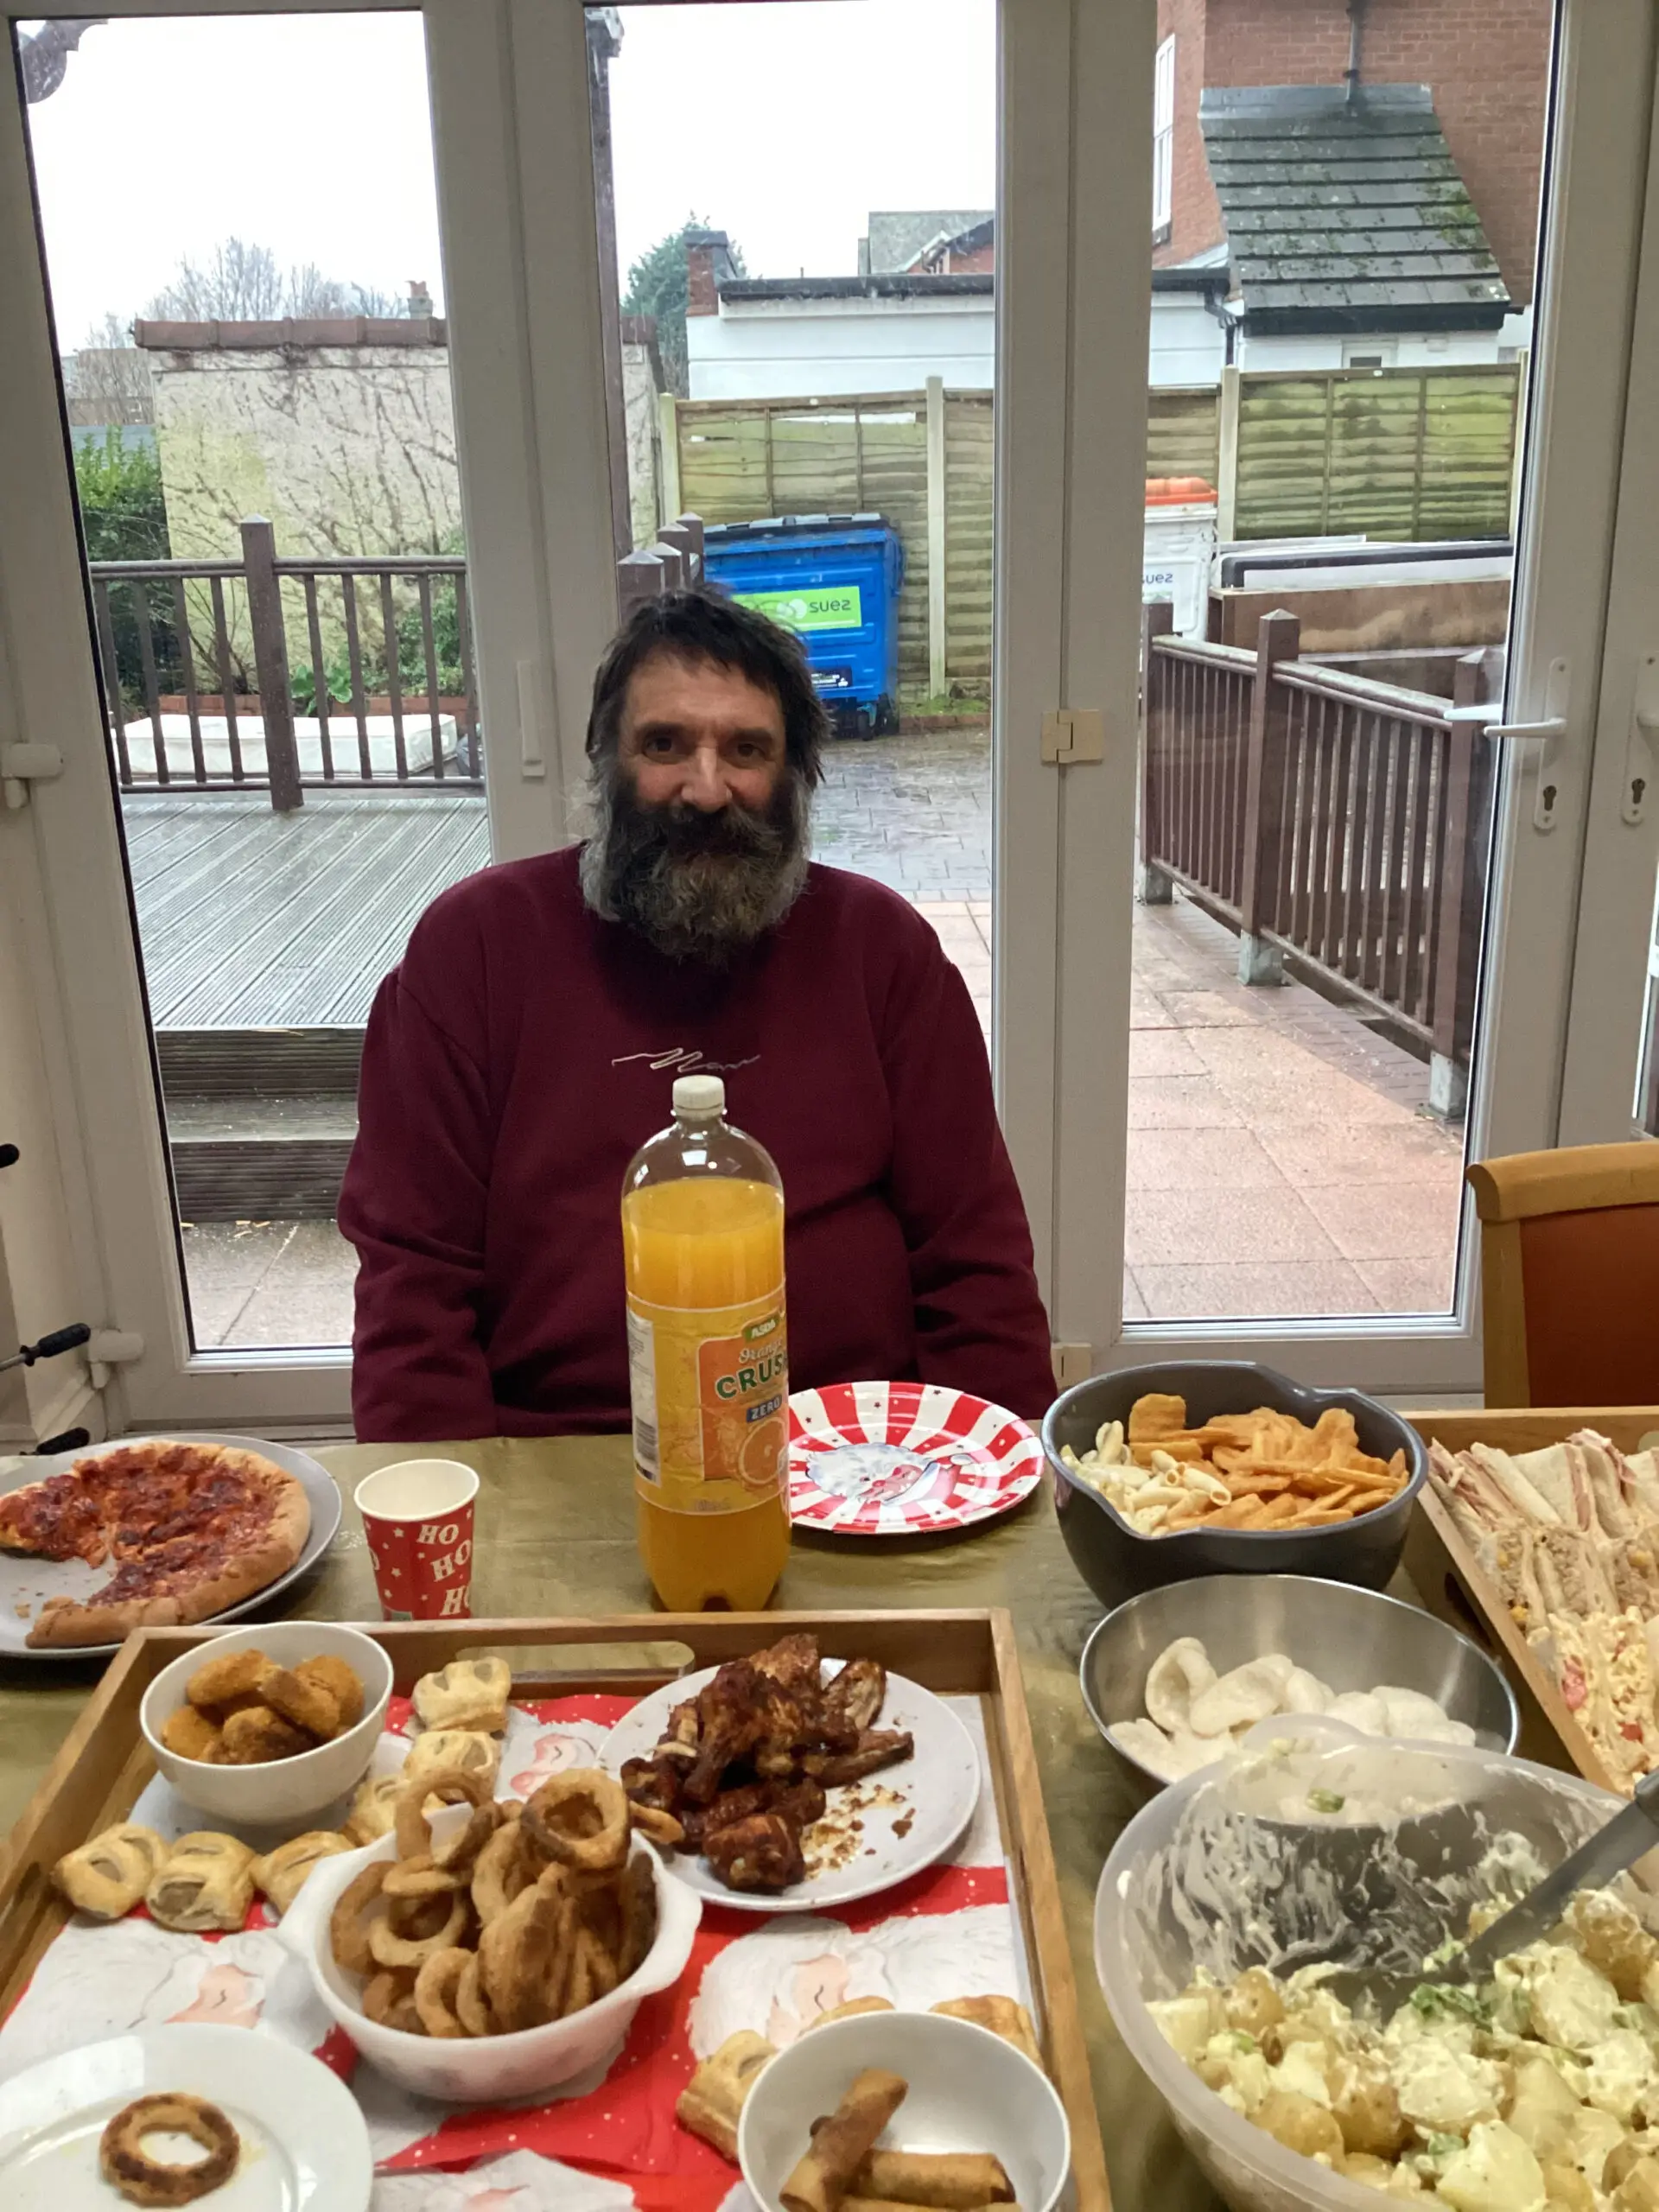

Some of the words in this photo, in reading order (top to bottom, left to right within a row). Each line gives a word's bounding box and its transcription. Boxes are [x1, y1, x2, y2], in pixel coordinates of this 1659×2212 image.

[809, 599, 852, 613] suez
[750, 1319, 777, 1339] ASDA
[715, 1351, 786, 1400] CRUS
[750, 1395, 781, 1421] ZERO
[416, 1523, 460, 1545] HO
[430, 1539, 472, 1583] HO
